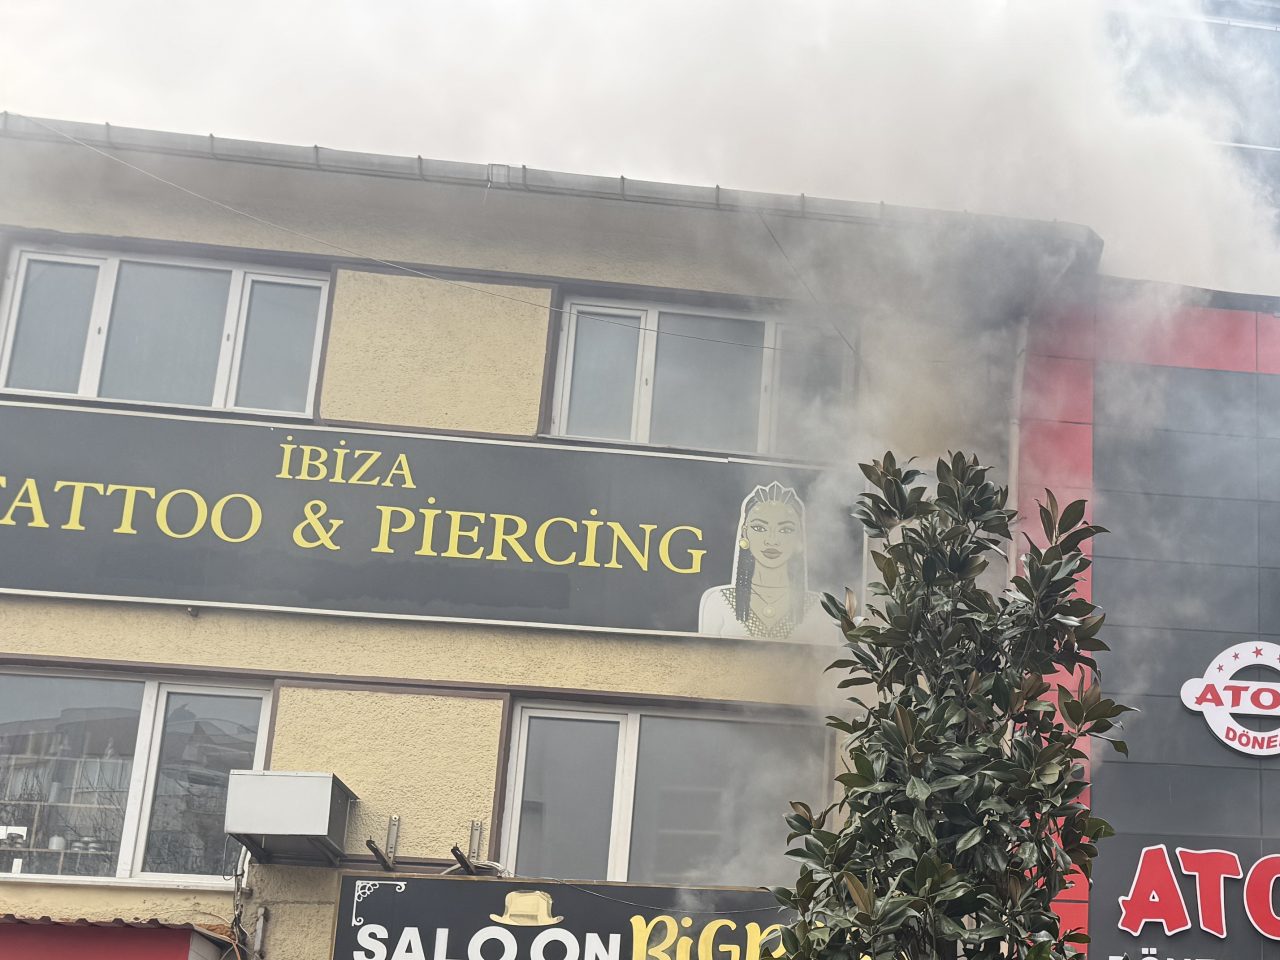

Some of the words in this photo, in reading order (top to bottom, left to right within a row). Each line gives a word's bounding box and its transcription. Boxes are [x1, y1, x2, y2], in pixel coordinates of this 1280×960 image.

[276, 435, 417, 489] İBİZA
[0, 476, 262, 543] ATTOO
[292, 499, 344, 551] &
[370, 496, 707, 574] PİERCİNG
